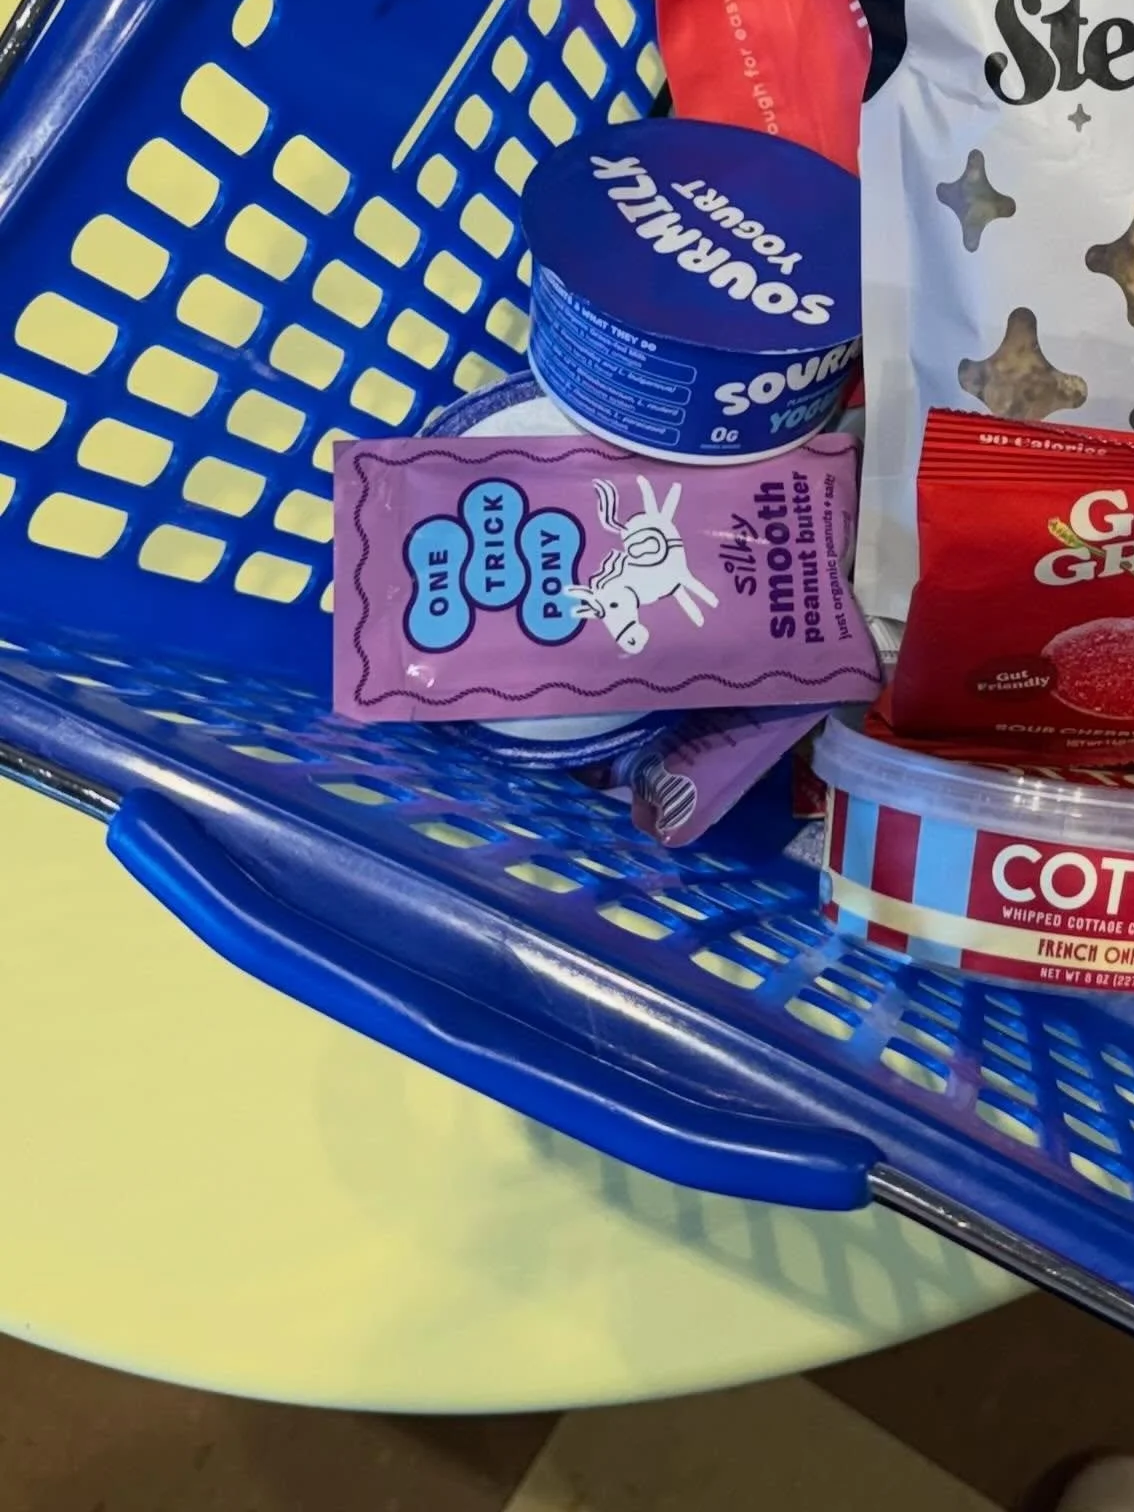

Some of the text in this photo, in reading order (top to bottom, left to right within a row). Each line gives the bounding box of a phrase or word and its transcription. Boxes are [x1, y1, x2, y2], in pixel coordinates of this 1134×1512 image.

[740, 48, 759, 78] for
[753, 83, 779, 136] ough
[589, 156, 835, 325] SOURMILK
[671, 179, 803, 275] YOGURT
[611, 325, 638, 344] THEY
[641, 340, 657, 351] DO
[1014, 436, 1107, 457] Calories
[483, 494, 505, 592] TRICK
[718, 513, 759, 597] silky
[792, 471, 825, 644] peanut butter
[822, 510, 838, 558] peanuts
[429, 549, 449, 617] ONE
[540, 530, 562, 619] PONY
[753, 481, 796, 639] smooth
[826, 559, 844, 611] organic
[834, 612, 853, 641] just
[977, 675, 1050, 692] Friendly
[996, 669, 1029, 683] Gut
[995, 723, 1055, 734] SOUR
[1002, 906, 1062, 928] WHIPPED
[1067, 916, 1122, 934] COTTAGE
[1037, 938, 1098, 963] FRENCH
[1040, 968, 1061, 980] NET
[1065, 970, 1081, 983] WT
[1096, 974, 1110, 985] OZ
